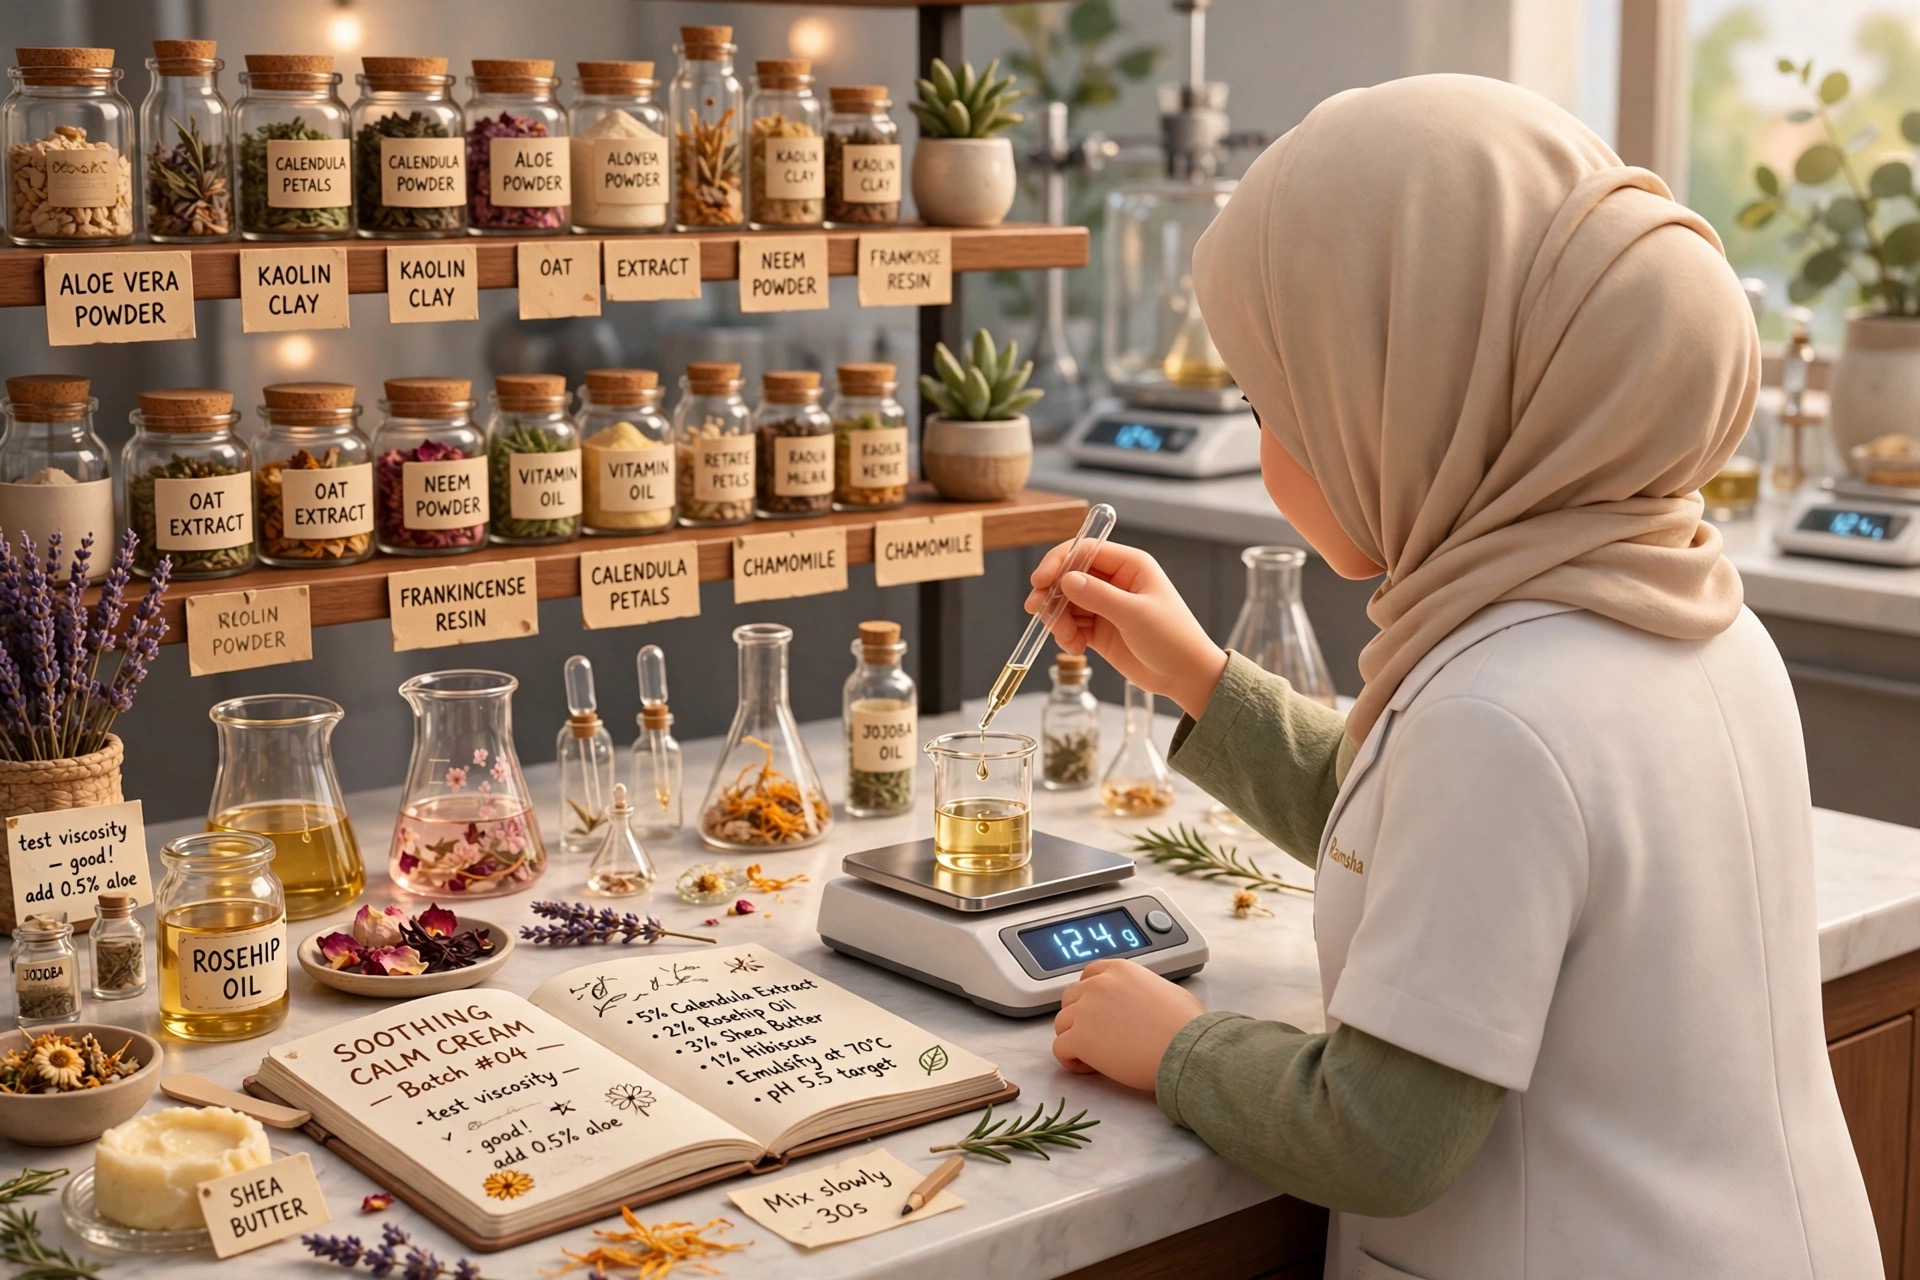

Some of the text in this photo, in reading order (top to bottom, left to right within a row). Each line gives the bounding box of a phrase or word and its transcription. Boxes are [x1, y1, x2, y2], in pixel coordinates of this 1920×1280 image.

[275, 156, 347, 171] CALENDULA
[388, 154, 460, 171] CALENDULA
[515, 151, 554, 168] ALOE
[776, 150, 818, 163] KAOLIN
[852, 158, 896, 173] KAOLIN
[283, 177, 332, 193] PETALS
[397, 175, 456, 192] POWDER
[503, 174, 563, 192] POWDER
[605, 172, 661, 189] POWDER
[784, 168, 816, 184] CLAY
[860, 177, 891, 192] CLAY
[400, 259, 466, 281] KAOLIN
[540, 258, 573, 276] OAT
[617, 257, 690, 278] EXTRACT
[761, 252, 805, 270] NEEM
[59, 270, 179, 296] ALOE VERA
[258, 264, 331, 286] KAOLIN
[887, 271, 932, 291] RESIN
[409, 287, 455, 308] CLAY
[752, 277, 817, 297] POWDER
[75, 302, 167, 328] POWDER
[268, 294, 319, 315] CLAY
[519, 466, 578, 485] VITAMIN
[608, 460, 670, 480] VITAMIN
[315, 481, 348, 500] OAT
[424, 474, 471, 494] NEEM
[629, 485, 655, 502] OIL
[189, 492, 225, 510] OAT
[416, 497, 482, 518] POWDER
[540, 490, 566, 508] OIL
[170, 514, 244, 537] EXTRACT
[295, 504, 366, 526] EXTRACT
[885, 535, 973, 561] CHAMOMILE
[591, 558, 688, 586] CALENDULA
[743, 549, 836, 578] CHAMOMILE
[400, 576, 527, 608] FRANKINCENSE
[610, 587, 670, 611] PETALS
[435, 612, 487, 632] RESIN
[212, 631, 286, 656] POWDER
[879, 745, 902, 760] OIL
[18, 820, 128, 851] test viscosity
[70, 845, 114, 876] good!
[1329, 836, 1364, 875] Ramsha
[25, 871, 138, 903] add 0.5% aloe
[1053, 922, 1139, 960] 12.4 g
[193, 937, 280, 973] ROSEHIP
[22, 965, 64, 982] JOJOBA
[223, 975, 262, 1000] OIL
[635, 977, 819, 1024] 5% Calendula Extract
[662, 999, 797, 1038] 2% Rosehip Oil
[333, 1004, 492, 1064] SOOTHING
[684, 1011, 824, 1054] 3% Shea Butter
[350, 1019, 535, 1086] CALM CREAM
[711, 1034, 817, 1068] 1% Hibiscus
[736, 1036, 893, 1085] Emulsify at 70°C
[397, 1045, 529, 1099] Batch #04
[766, 1056, 898, 1104] pH 5.5 target
[426, 1070, 559, 1122] test viscosity
[481, 1119, 533, 1154] good!
[493, 1115, 624, 1170] add 0.5% aloe
[230, 1176, 284, 1208] SHEA
[763, 1169, 892, 1213] Mix slowly
[230, 1197, 308, 1238] BUTTER
[816, 1202, 868, 1224] 30s
